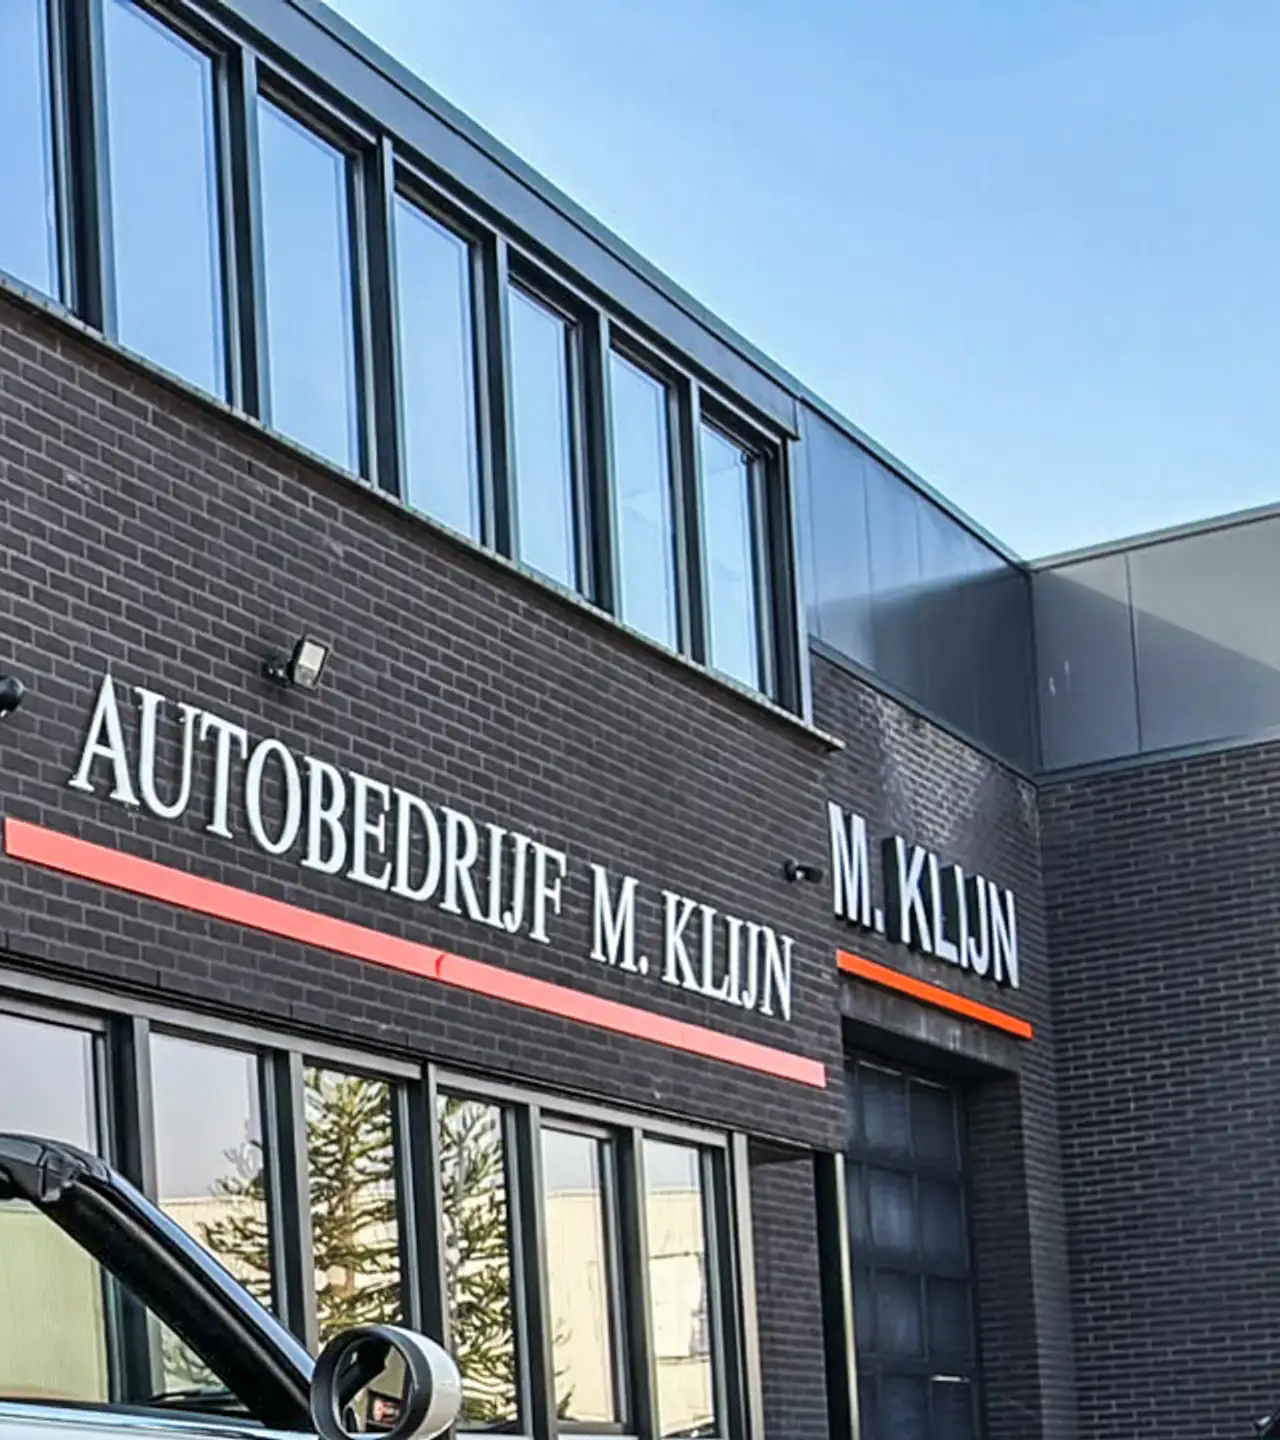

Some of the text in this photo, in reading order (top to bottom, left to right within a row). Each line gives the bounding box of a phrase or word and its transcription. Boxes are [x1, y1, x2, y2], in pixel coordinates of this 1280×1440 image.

[67, 672, 796, 1022] AUTOBEDRIJF M. KLIJN
[827, 799, 1020, 990] M. KLIJN
